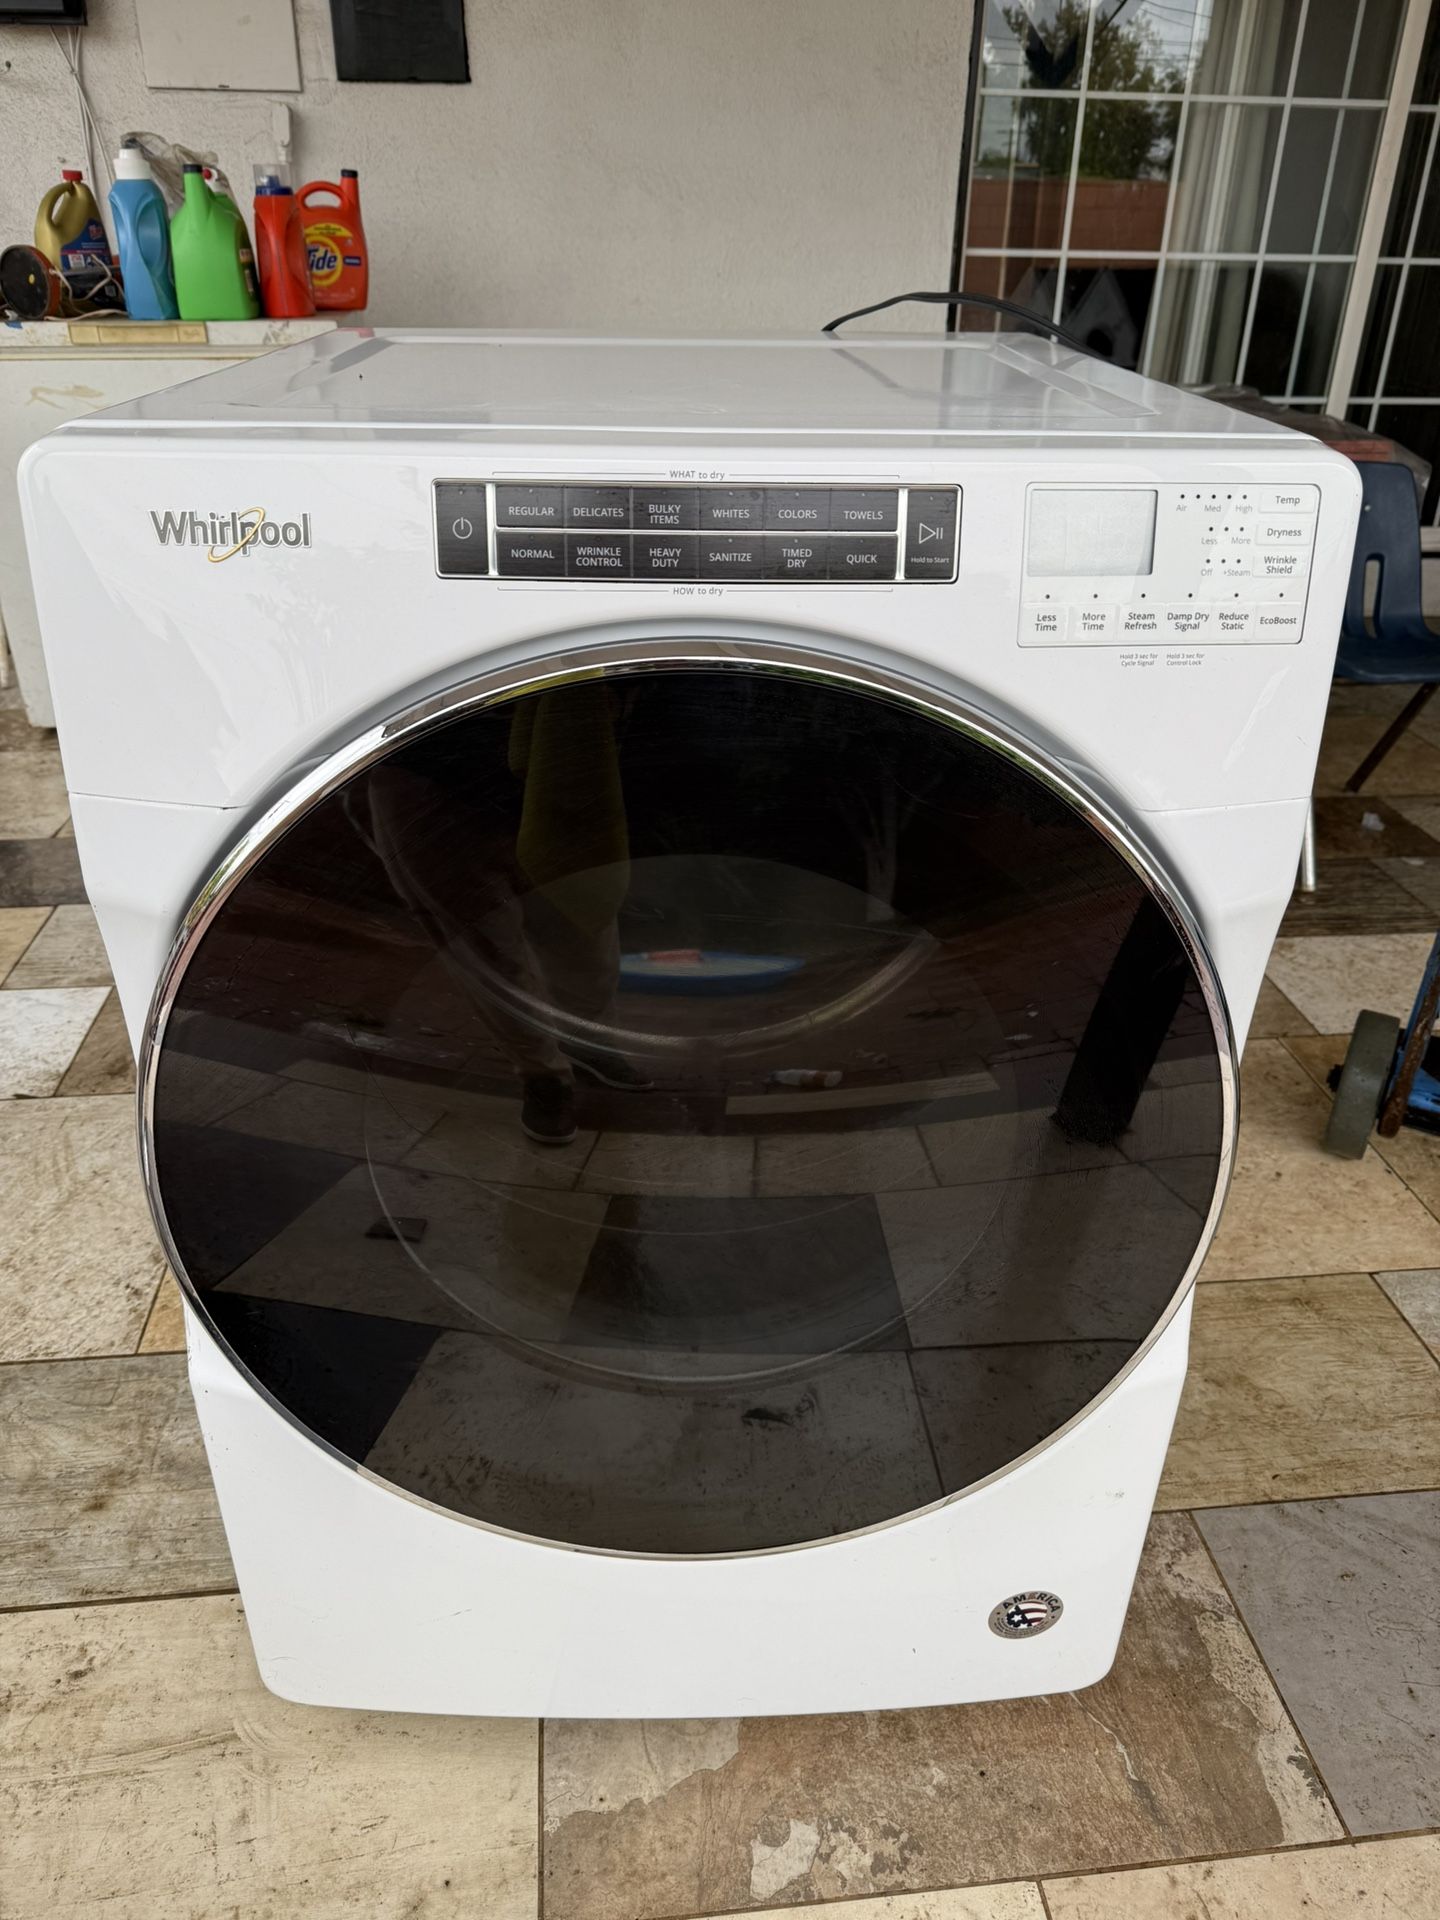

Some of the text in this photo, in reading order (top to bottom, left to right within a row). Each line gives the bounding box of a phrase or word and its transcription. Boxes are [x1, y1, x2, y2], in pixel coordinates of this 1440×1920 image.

[307, 248, 338, 271] Tide
[669, 470, 725, 480] WHAT to dry
[1275, 496, 1300, 506] Temp
[508, 506, 554, 516] REGULAR
[573, 507, 624, 518] DELICATES
[648, 504, 681, 514] BULKY
[712, 509, 750, 519] WHITES
[778, 509, 817, 519] COLORS
[1176, 504, 1253, 514] Air Med High
[650, 514, 680, 525] ITEMS
[844, 510, 883, 520] TOWELS
[150, 510, 310, 555] Whirlpool
[1266, 528, 1302, 538] Dryness
[1201, 537, 1251, 545] Less More
[511, 549, 554, 559] NORMAL
[576, 547, 622, 557] WRINKLE
[649, 547, 681, 557] HEAVY
[709, 552, 752, 562] SANITIZE
[782, 548, 812, 558] TIMED
[575, 557, 623, 567] CONTROL
[652, 558, 679, 568] DUTY
[787, 559, 807, 568] DRY
[846, 554, 877, 565] QUICK
[1264, 555, 1297, 564] Wrinkle
[1201, 568, 1213, 577] Off
[1266, 565, 1293, 574] Shield
[673, 587, 723, 596] HOW to dry
[1037, 613, 1057, 622] Less
[1082, 612, 1106, 621] More
[1128, 612, 1155, 621] Steam
[1167, 612, 1209, 622] Damp Dry
[1219, 612, 1249, 621] Reduce
[1259, 616, 1297, 625] EcoBoost
[1035, 622, 1057, 632] Time
[1082, 622, 1104, 631] Time
[1124, 621, 1157, 631] Refresh
[1174, 621, 1200, 632] Signal
[1221, 621, 1244, 630] Static
